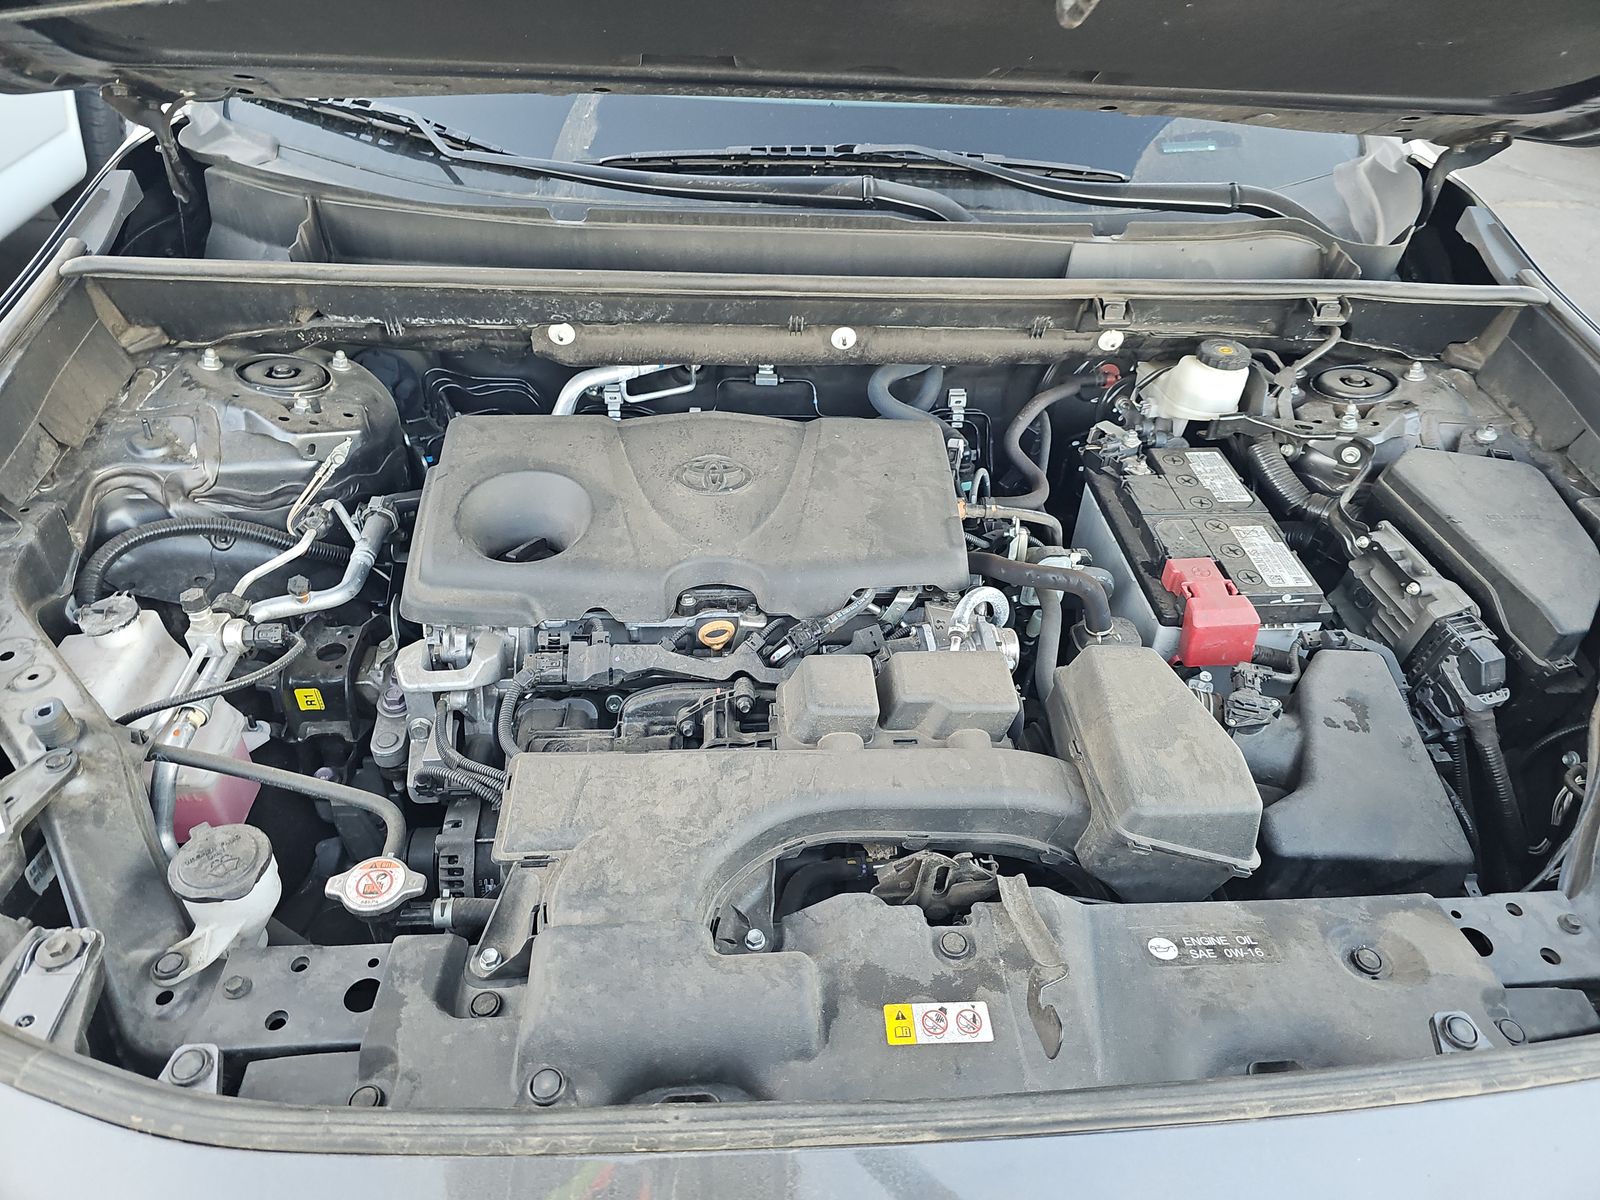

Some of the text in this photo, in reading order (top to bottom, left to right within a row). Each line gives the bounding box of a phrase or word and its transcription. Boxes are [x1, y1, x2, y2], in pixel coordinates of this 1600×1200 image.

[303, 694, 317, 706] R1
[1181, 935, 1259, 947] ENGINE OIL
[1189, 947, 1265, 959] SAE 0W-16
